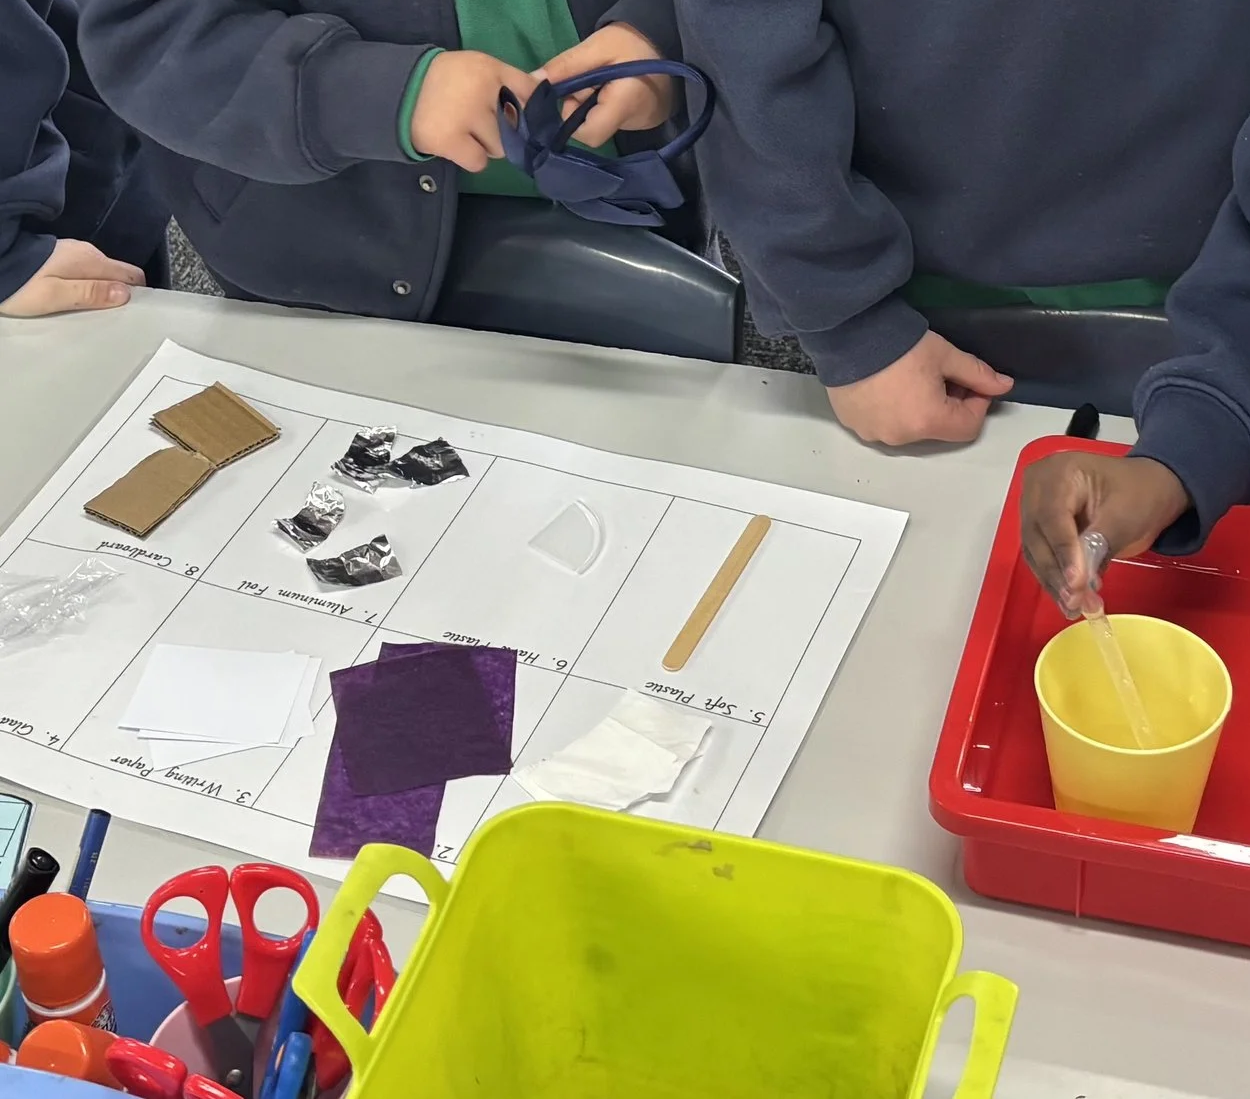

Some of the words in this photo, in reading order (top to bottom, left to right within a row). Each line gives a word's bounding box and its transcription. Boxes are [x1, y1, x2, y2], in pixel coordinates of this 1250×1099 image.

[96, 541, 172, 567] Cardboard
[184, 562, 200, 576] 8.
[237, 580, 269, 596] Foil
[278, 589, 353, 615] Aluminum
[364, 610, 378, 624] 7.
[552, 656, 568, 671] 6.
[645, 681, 696, 705] Plastic
[704, 696, 738, 715] Soft
[749, 709, 766, 724] 5.
[46, 731, 61, 746] 4.
[110, 756, 154, 778] Paper
[164, 765, 223, 797] Writing
[236, 789, 252, 804] 3.
[437, 844, 455, 859] 2.
